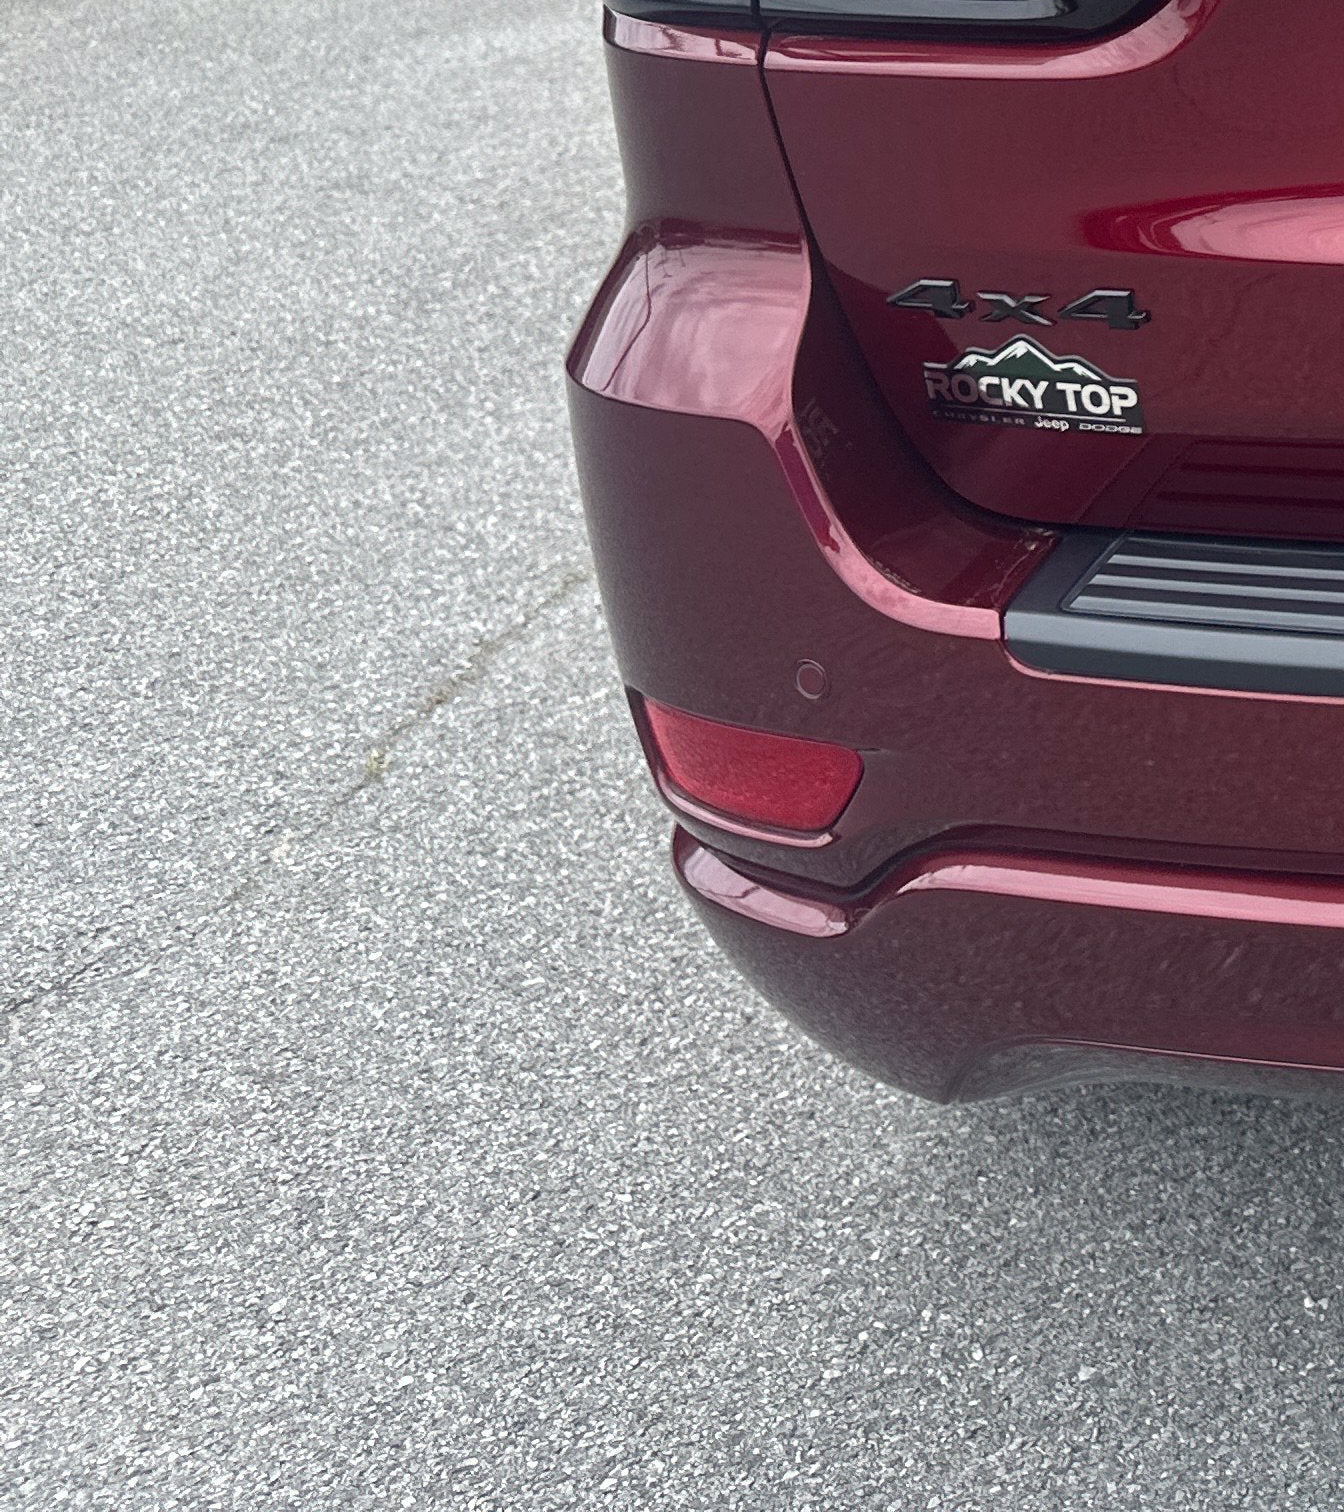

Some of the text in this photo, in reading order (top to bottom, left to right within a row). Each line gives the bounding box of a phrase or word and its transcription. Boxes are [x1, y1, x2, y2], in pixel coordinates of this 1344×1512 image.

[886, 277, 1152, 330] 4x4
[924, 369, 1138, 415] ROCKY TOP
[1034, 415, 1070, 432] Jeep
[1078, 422, 1143, 435] DODGE
